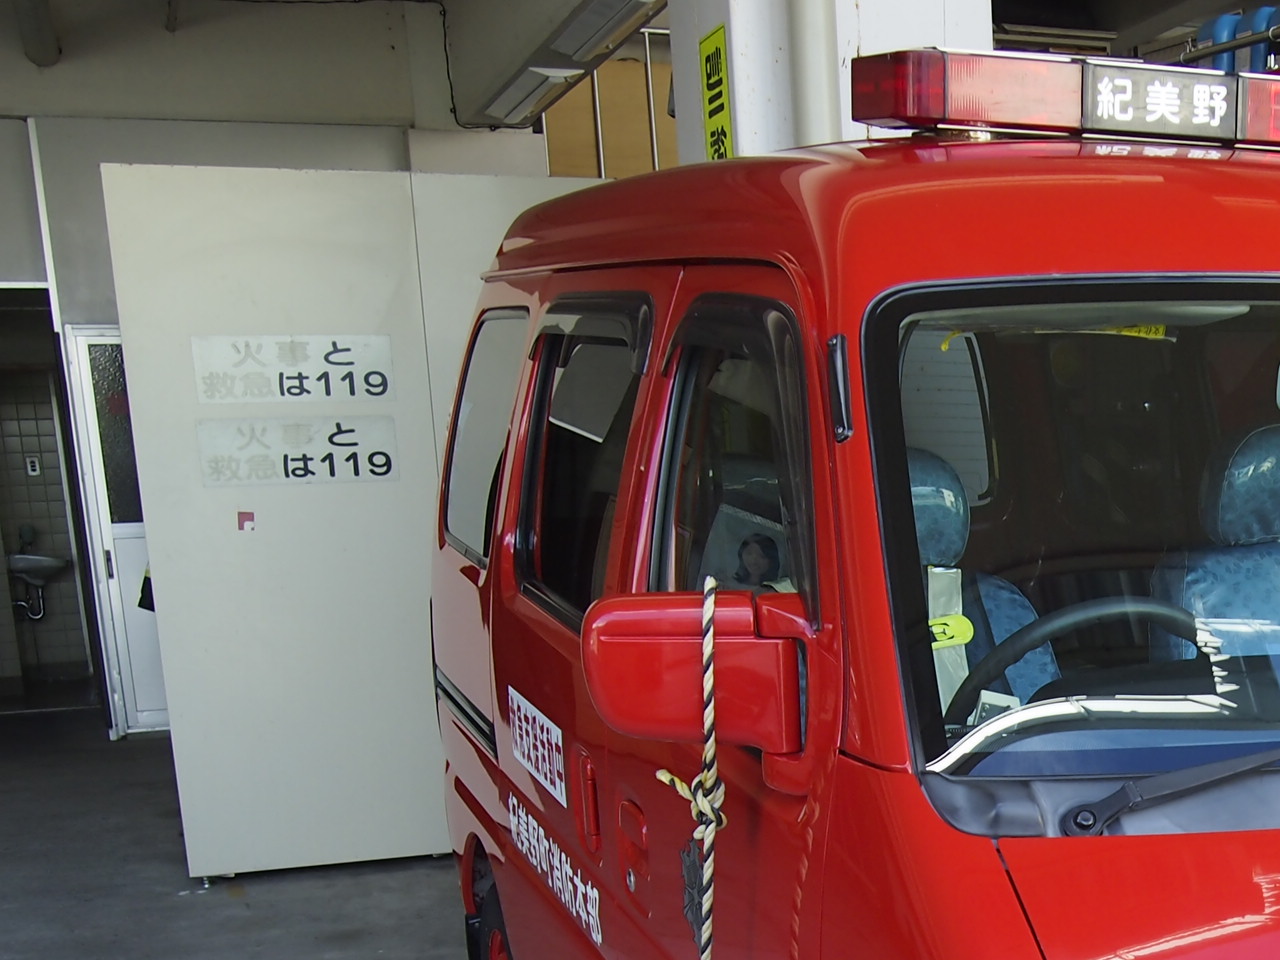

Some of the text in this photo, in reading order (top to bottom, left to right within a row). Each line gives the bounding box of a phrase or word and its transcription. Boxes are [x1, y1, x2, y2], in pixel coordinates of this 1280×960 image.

[1097, 76, 1228, 127] 紀美野
[508, 791, 603, 946] 紀美野町消防本部
